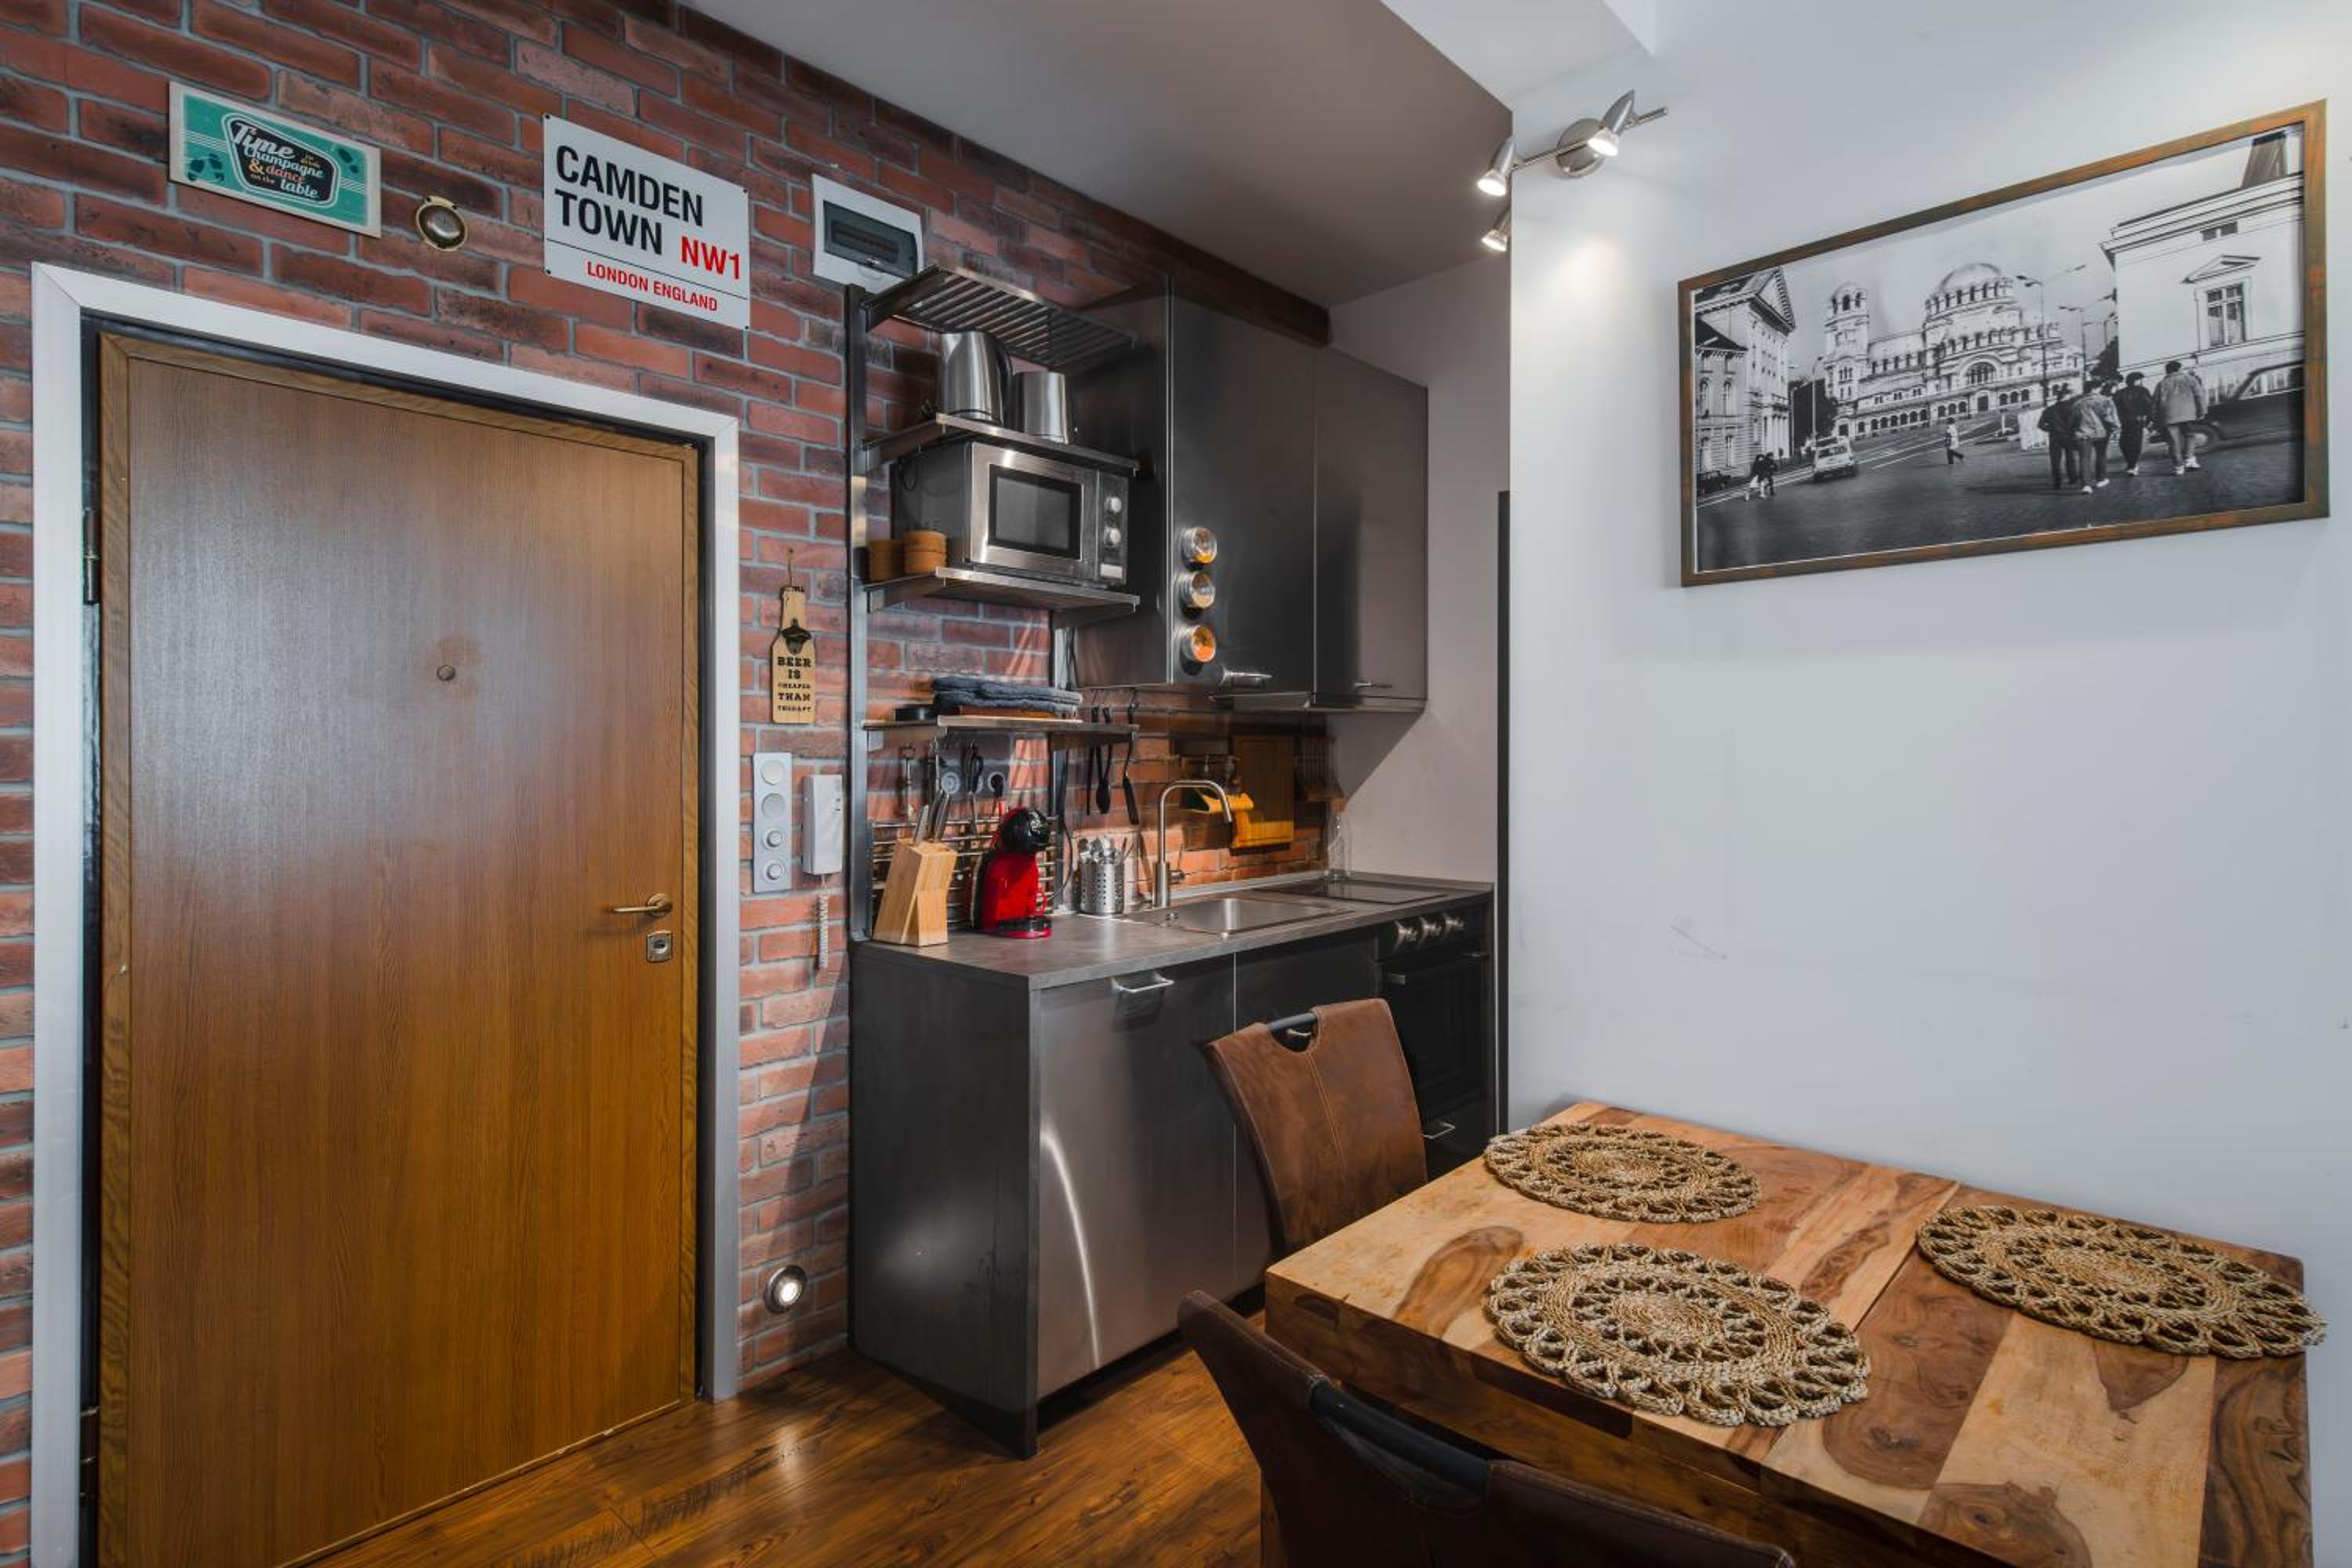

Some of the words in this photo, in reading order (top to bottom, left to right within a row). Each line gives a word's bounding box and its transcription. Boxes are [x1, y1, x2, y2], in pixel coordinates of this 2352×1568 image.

[280, 178, 318, 198] table
[556, 145, 703, 227] CAMDEN
[554, 188, 662, 256] TOWN
[681, 235, 740, 280] NW1
[587, 261, 649, 292] LONDON
[653, 281, 718, 311] ENGLAND
[777, 656, 811, 667] BEER
[789, 669, 800, 679] IS
[777, 692, 810, 702] THAN
